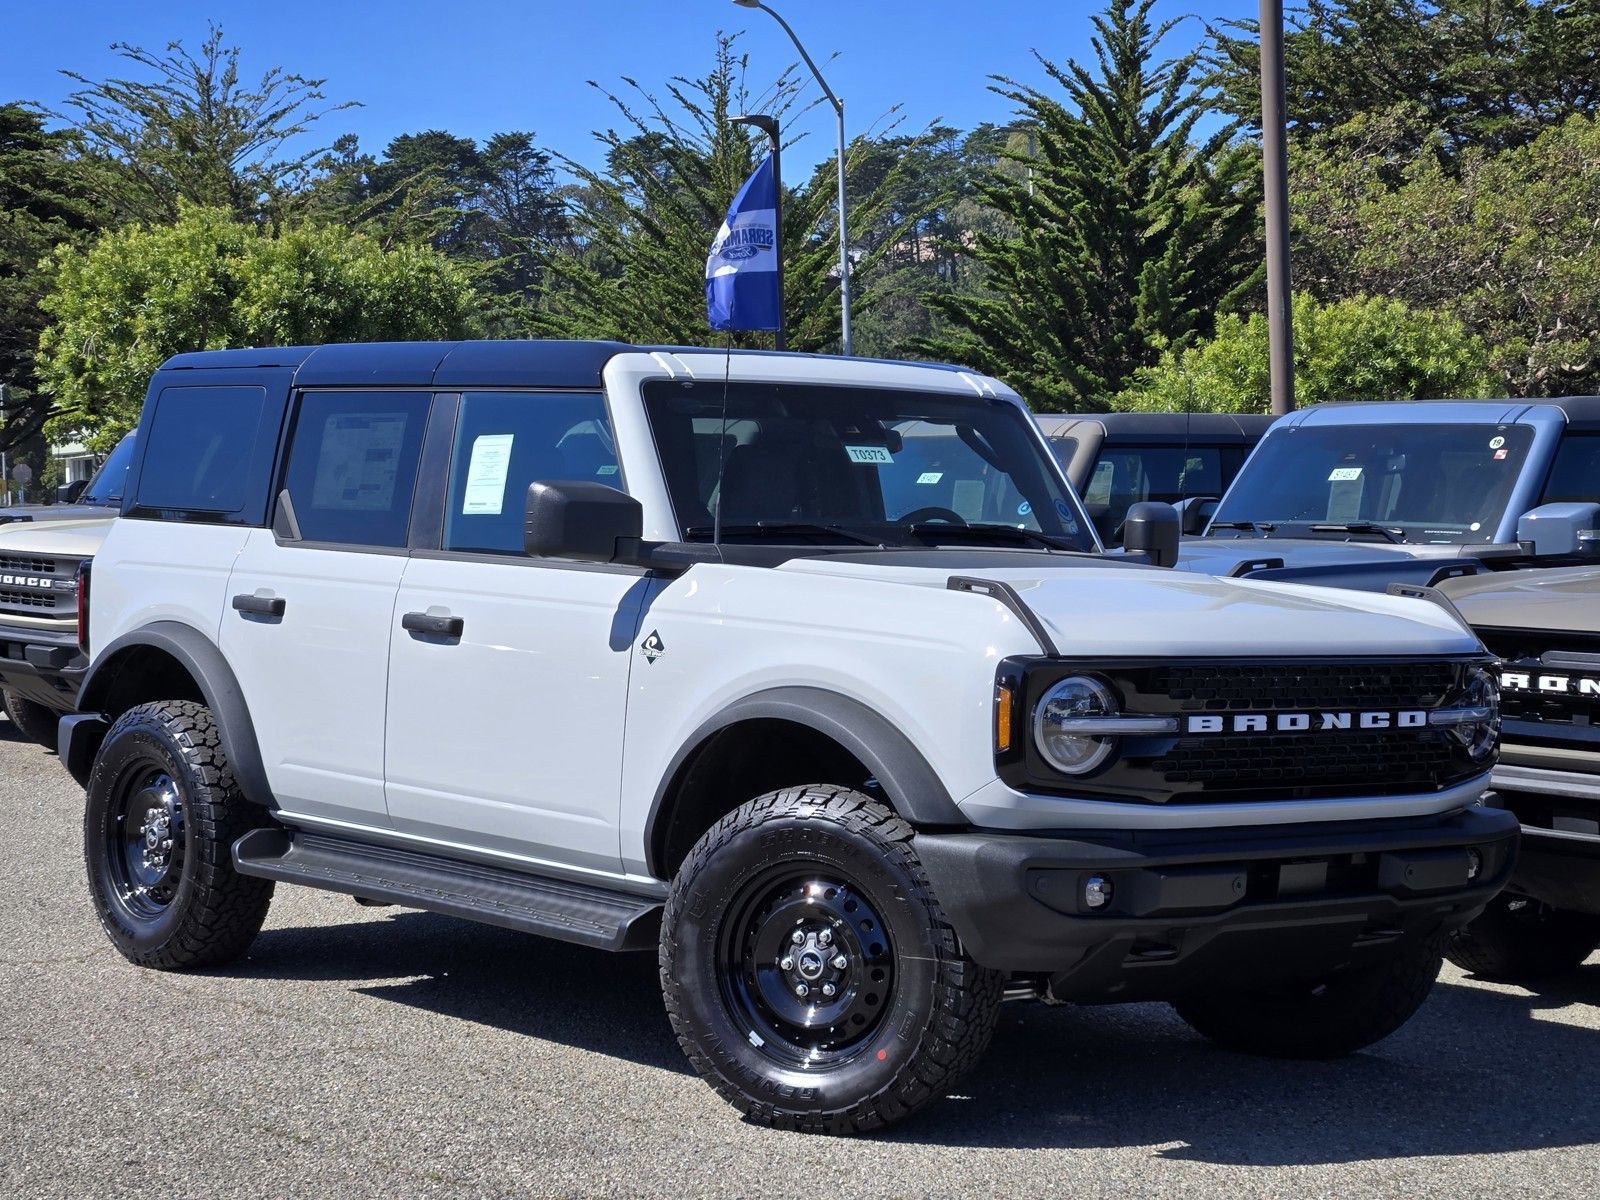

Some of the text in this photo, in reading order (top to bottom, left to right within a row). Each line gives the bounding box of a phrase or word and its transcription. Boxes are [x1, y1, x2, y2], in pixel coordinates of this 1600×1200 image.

[1493, 438, 1502, 447] 19
[851, 449, 886, 461] T0373
[0, 575, 52, 588] ONCO
[1188, 711, 1427, 733] BRONCO
